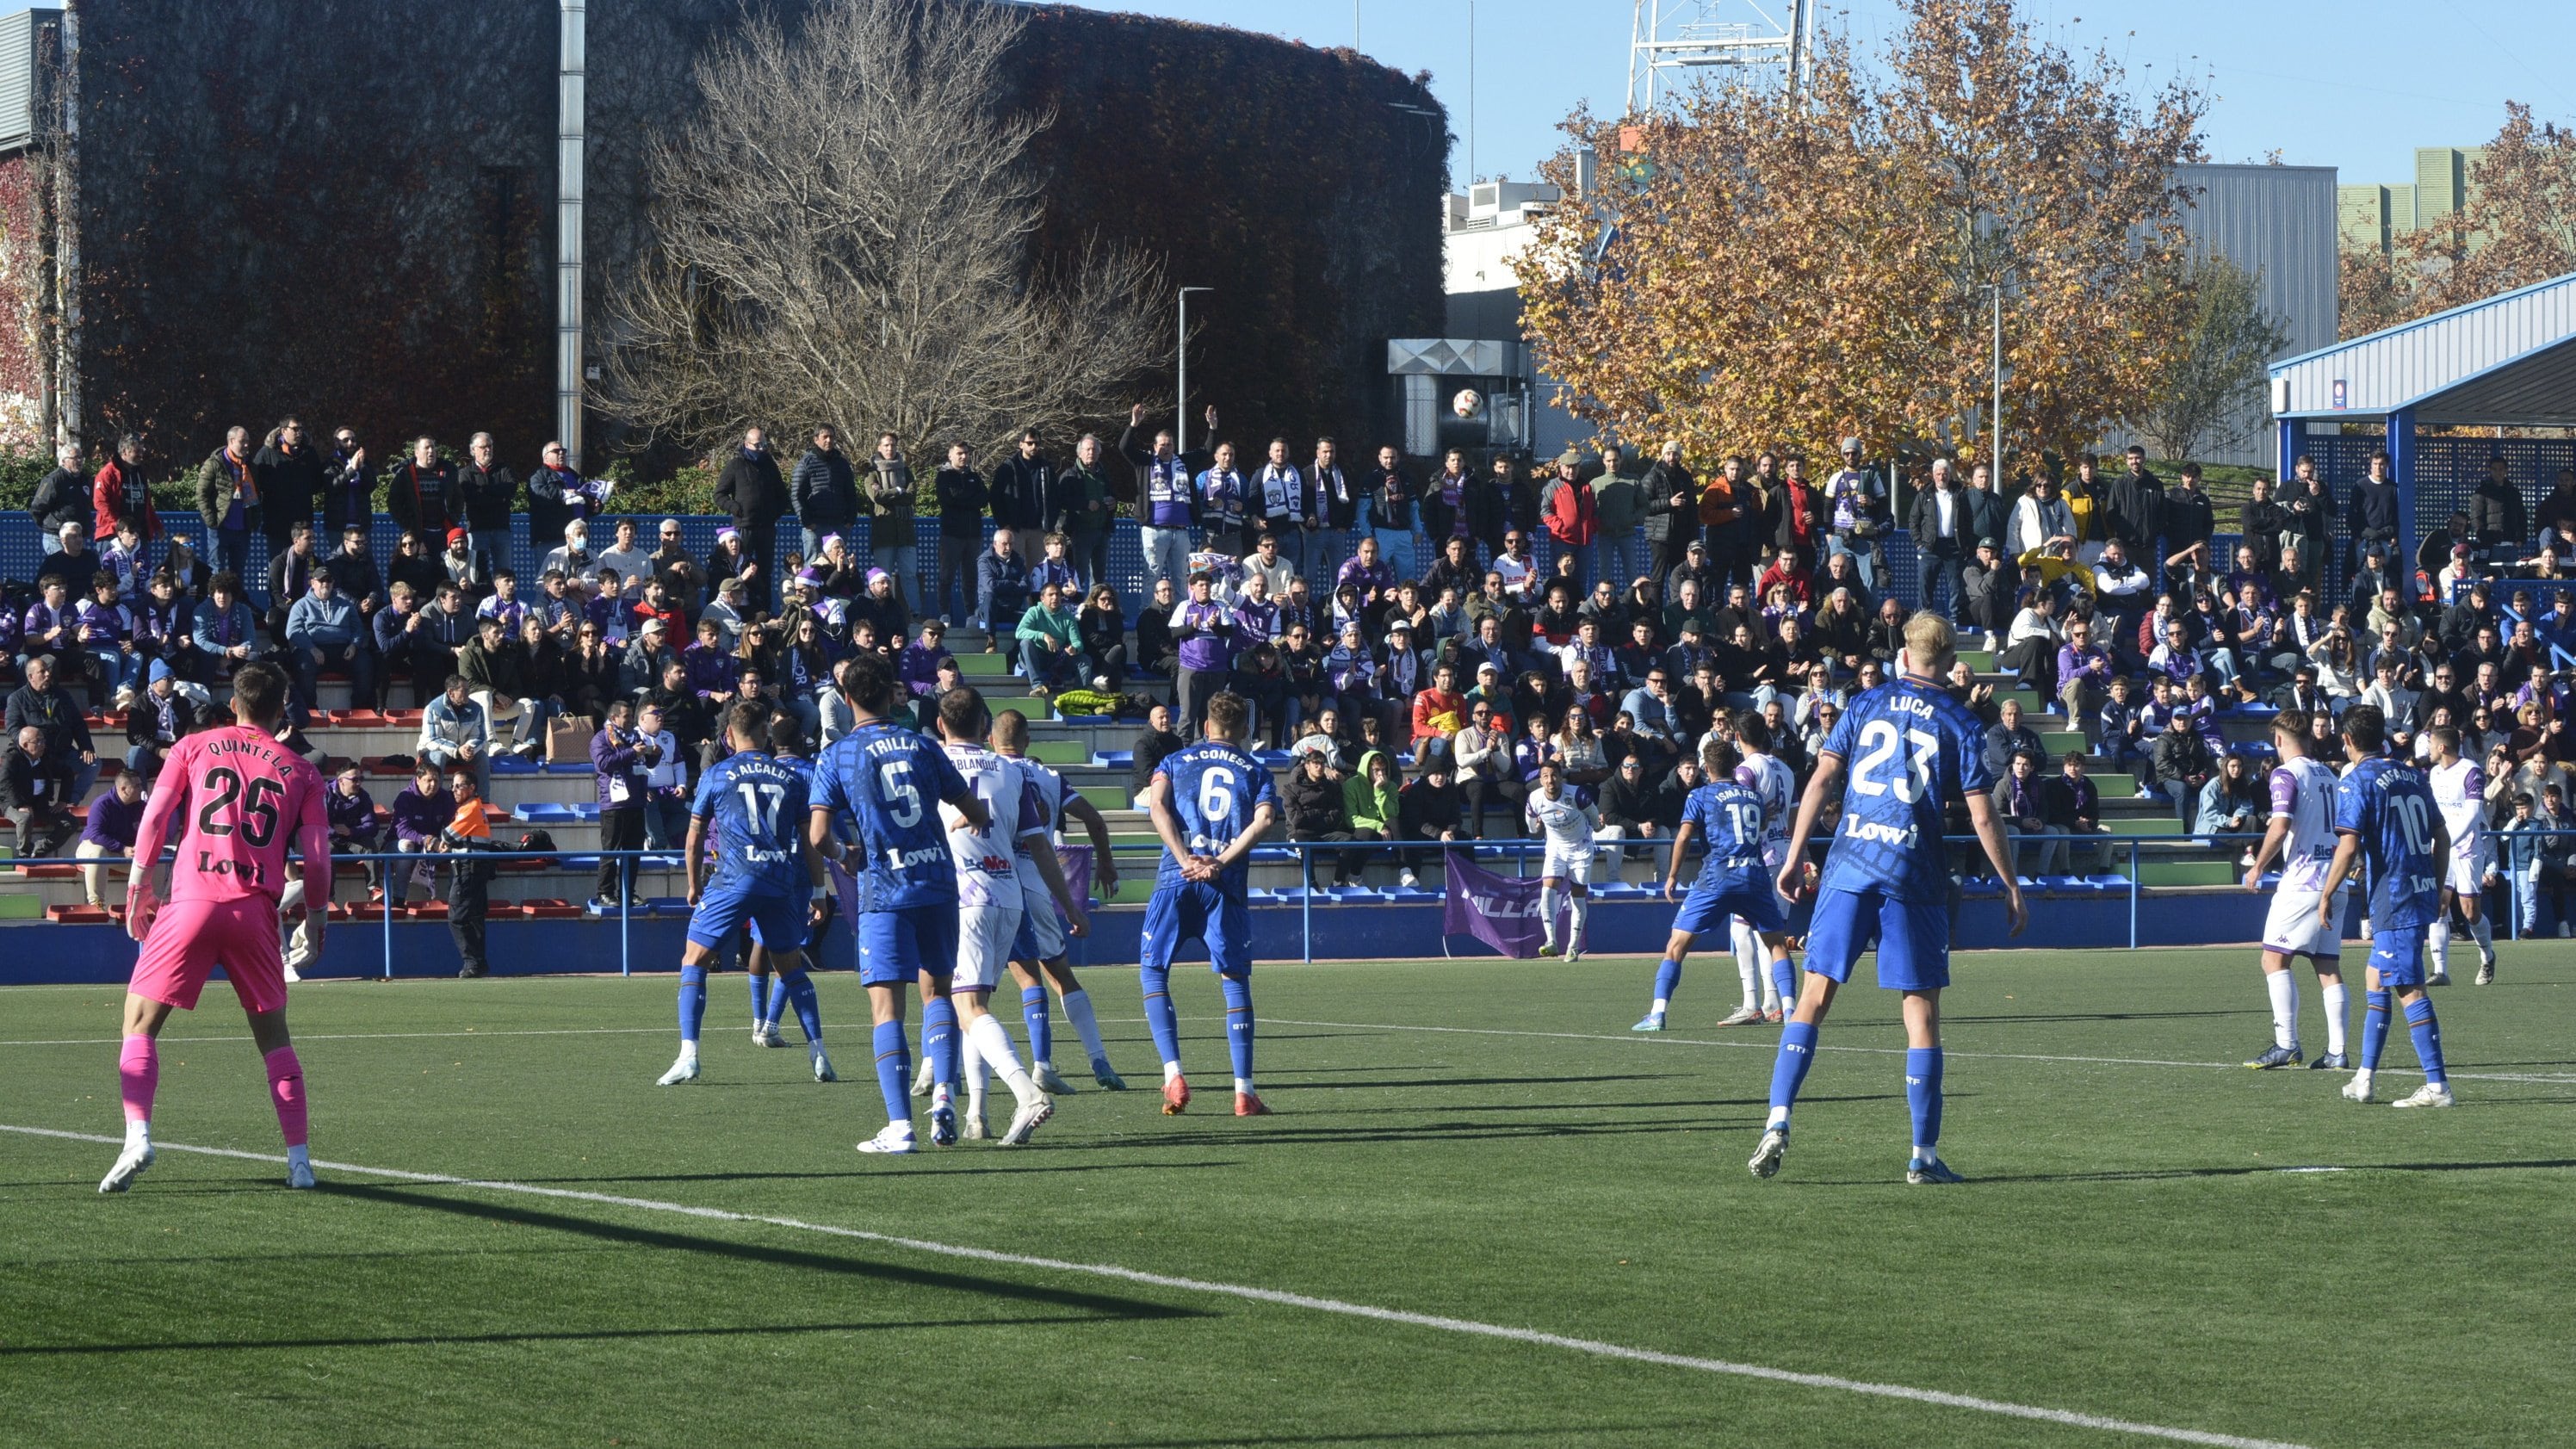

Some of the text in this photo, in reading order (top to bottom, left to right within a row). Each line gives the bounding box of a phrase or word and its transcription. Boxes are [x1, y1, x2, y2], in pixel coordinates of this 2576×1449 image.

[1890, 696, 1935, 720] LUCA
[208, 740, 293, 777] QUINTELA
[865, 737, 920, 758] TRILLA
[1852, 720, 1938, 804] 23
[198, 766, 287, 848] 25
[737, 783, 785, 837] 17
[880, 760, 923, 827] 5
[1198, 766, 1235, 821] 6
[1715, 789, 1742, 802] ISMA
[2319, 783, 2336, 833] 11
[1725, 803, 1761, 845] 19
[1845, 814, 1918, 849] Lowi
[2390, 795, 2432, 855] 10
[198, 851, 264, 885] Lowi
[887, 839, 946, 870] Lowi
